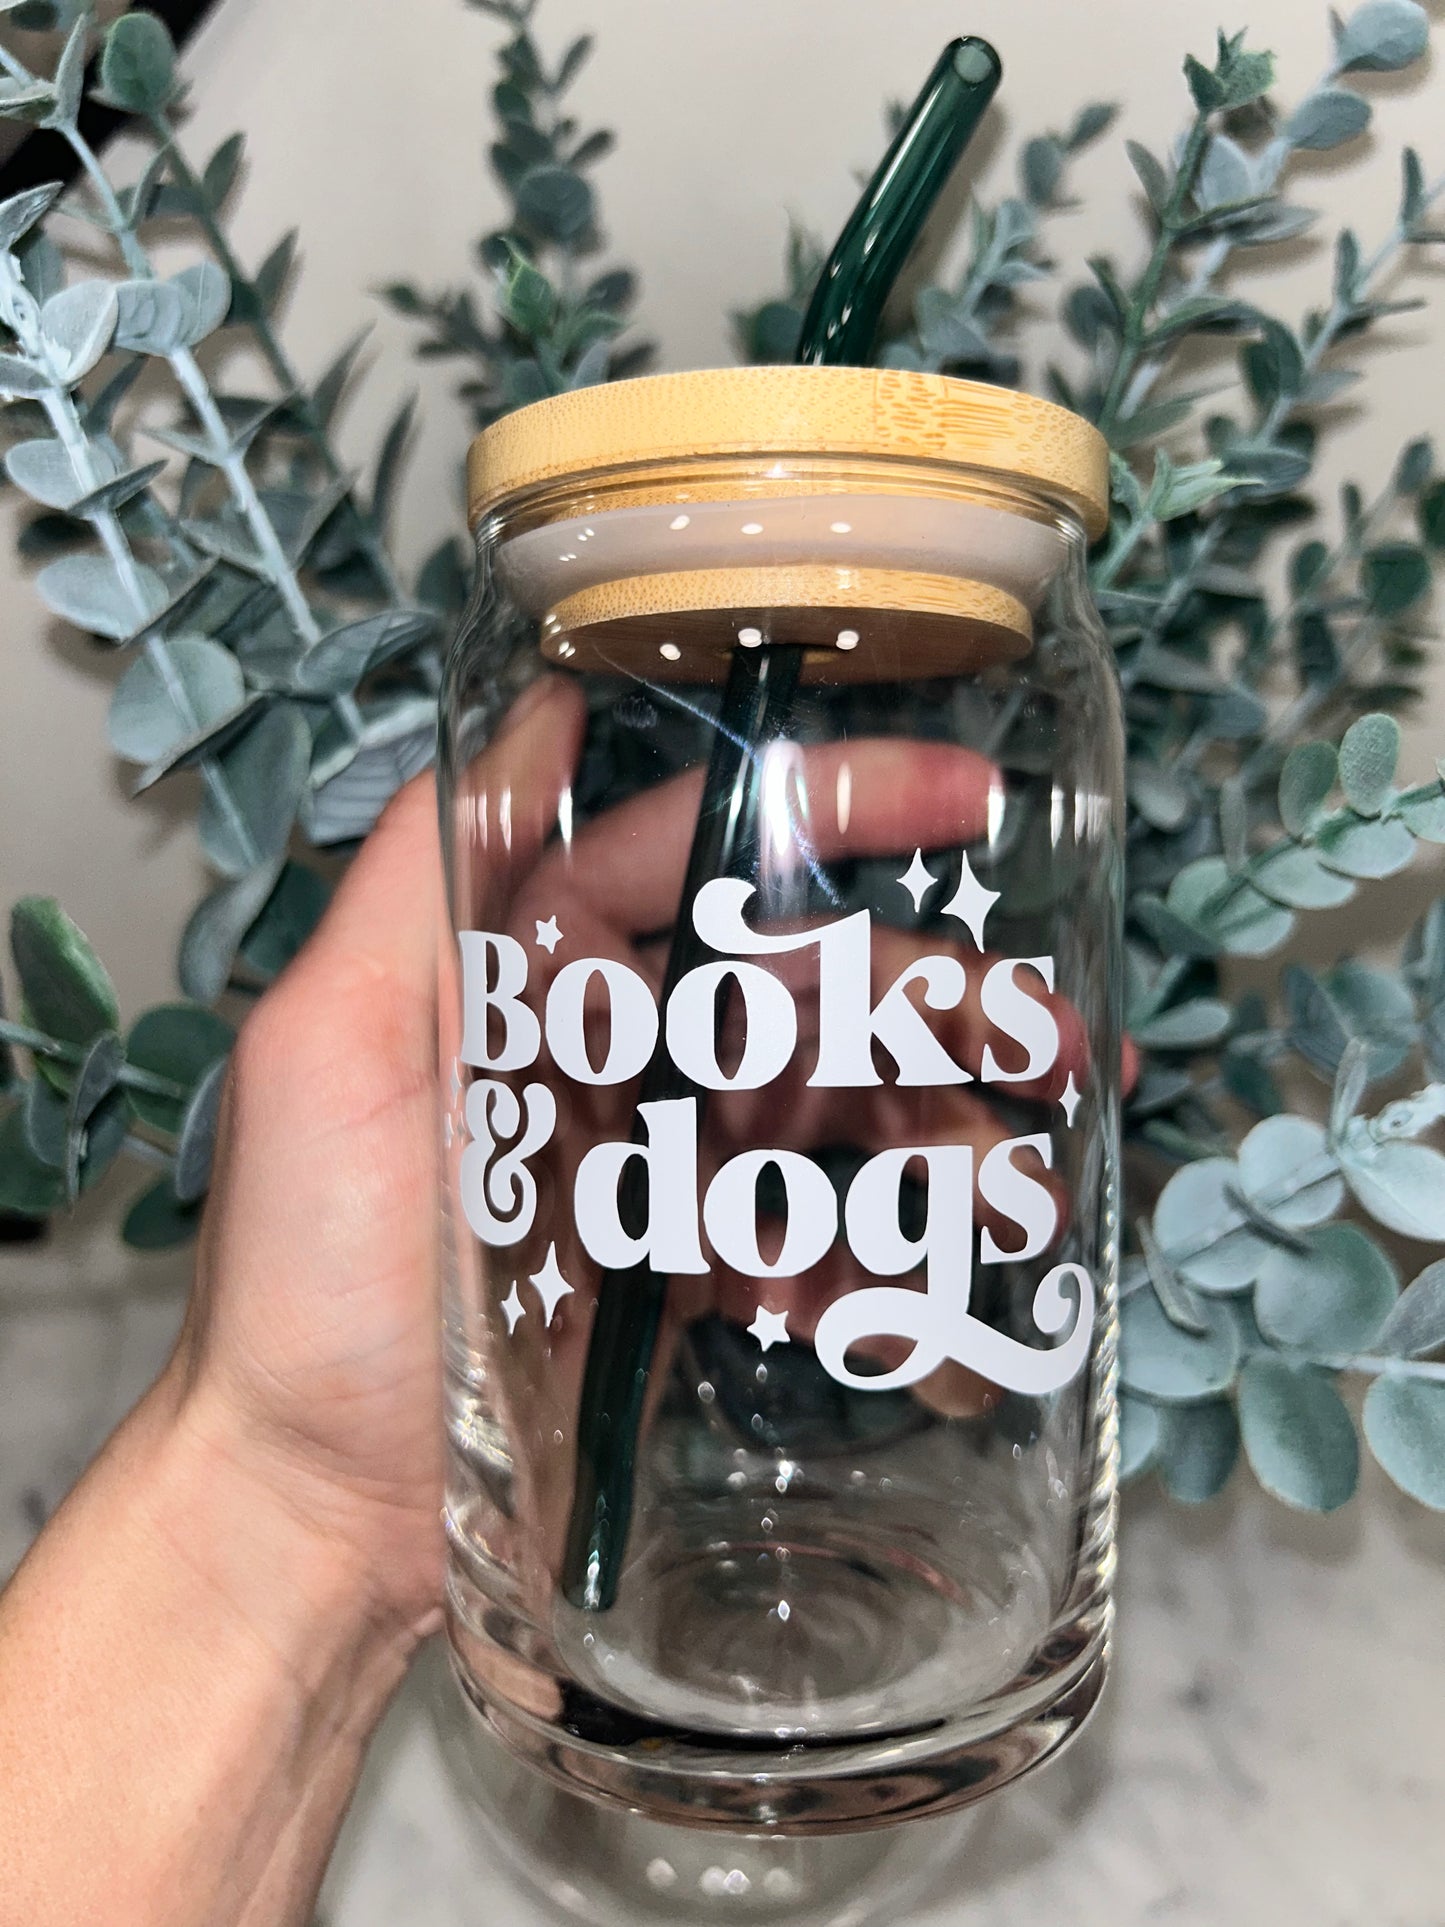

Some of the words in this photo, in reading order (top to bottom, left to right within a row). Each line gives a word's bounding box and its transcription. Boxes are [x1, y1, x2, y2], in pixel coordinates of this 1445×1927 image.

[458, 877, 1059, 1090] Books
[458, 1079, 557, 1246] &
[574, 1096, 1095, 1395] dogs
